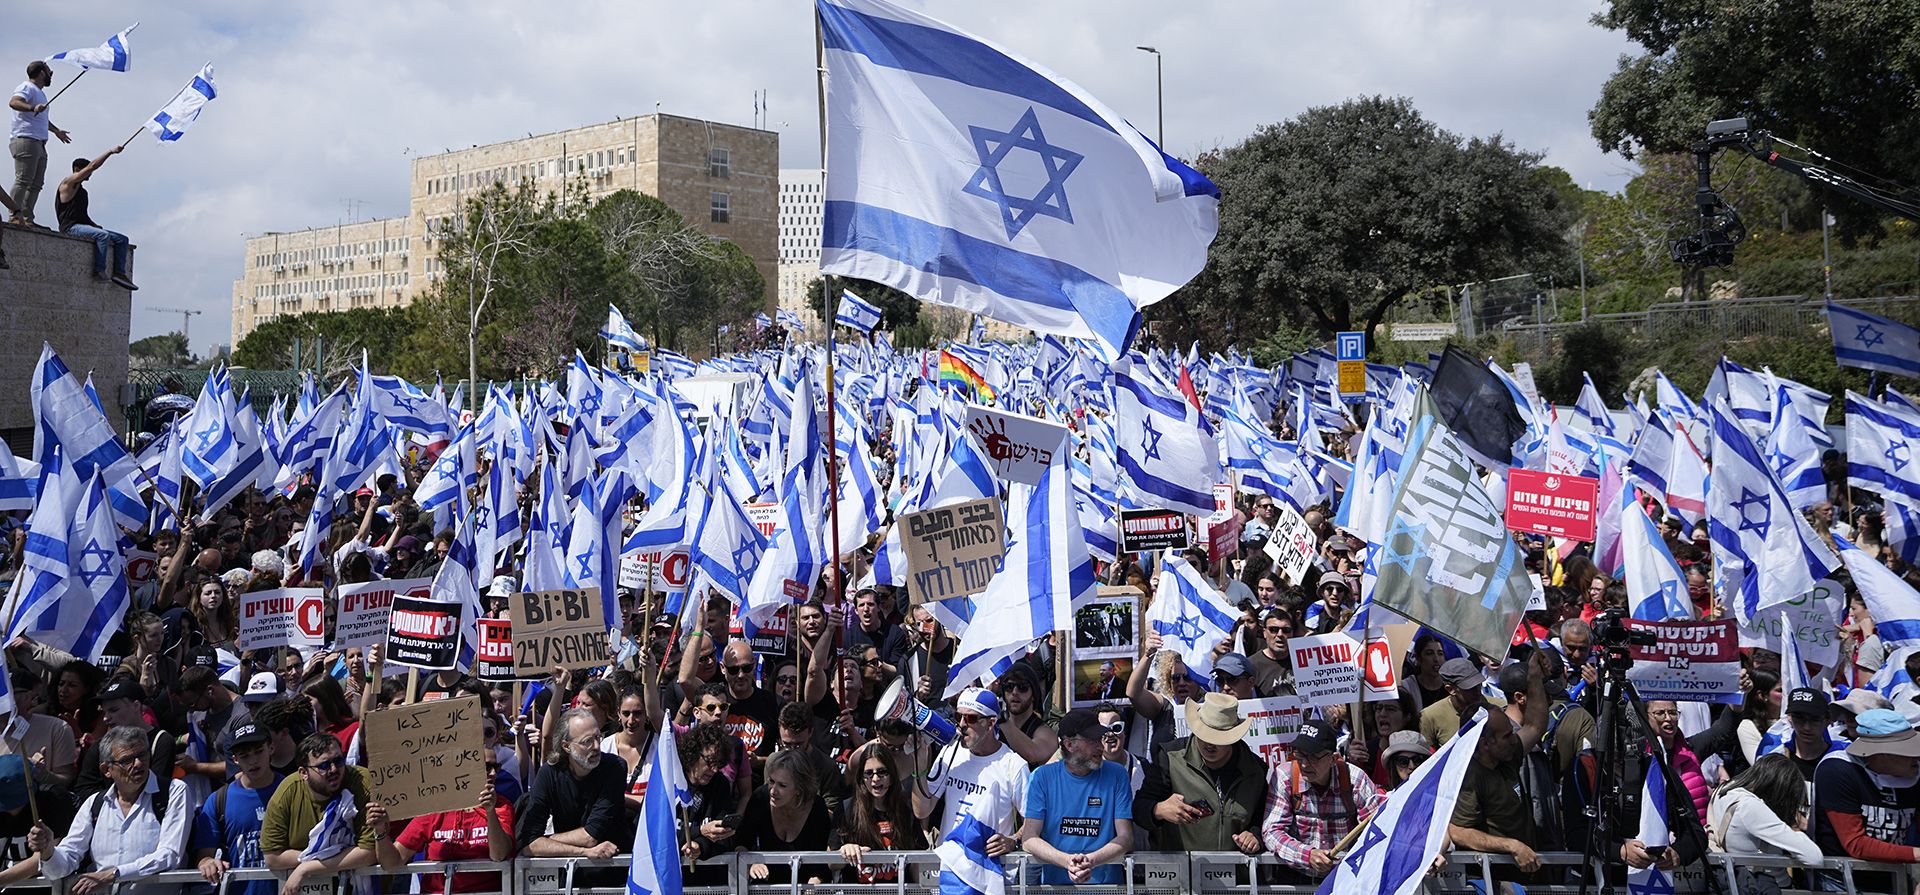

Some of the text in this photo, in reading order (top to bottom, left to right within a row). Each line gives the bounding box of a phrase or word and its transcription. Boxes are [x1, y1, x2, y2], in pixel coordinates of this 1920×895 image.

[1513, 491, 1590, 511] מציבות קו אדום
[909, 503, 995, 537] ביבי העם
[1169, 515, 1183, 529] לא
[1280, 521, 1293, 536] YOU
[1272, 529, 1305, 573] SIT WITH
[1278, 552, 1289, 569] US
[914, 559, 954, 601] לרוץ
[245, 597, 294, 618] עוצרים
[343, 590, 395, 612] עוצרים
[257, 616, 284, 625] החקיקה
[356, 611, 382, 620] החקיקה
[392, 610, 434, 636] אשתוק!
[1800, 610, 1824, 623] THE
[242, 625, 274, 635] דמוקרטית
[434, 615, 457, 636] לא
[1296, 643, 1352, 668] עוצרים
[1669, 656, 1689, 668] או
[1313, 667, 1342, 678] החקיקה
[1298, 677, 1333, 688] דמוקרטית
[1639, 692, 1716, 702] sraelhofsheet.org.il
[397, 709, 431, 731] לא
[401, 732, 458, 754] מאמינה
[369, 750, 481, 786] שאני עדיין מפגינה
[454, 773, 471, 790] על
[417, 784, 447, 797] החרא
[1061, 826, 1098, 837] אין הייטק
[1148, 871, 1177, 881] קשת
